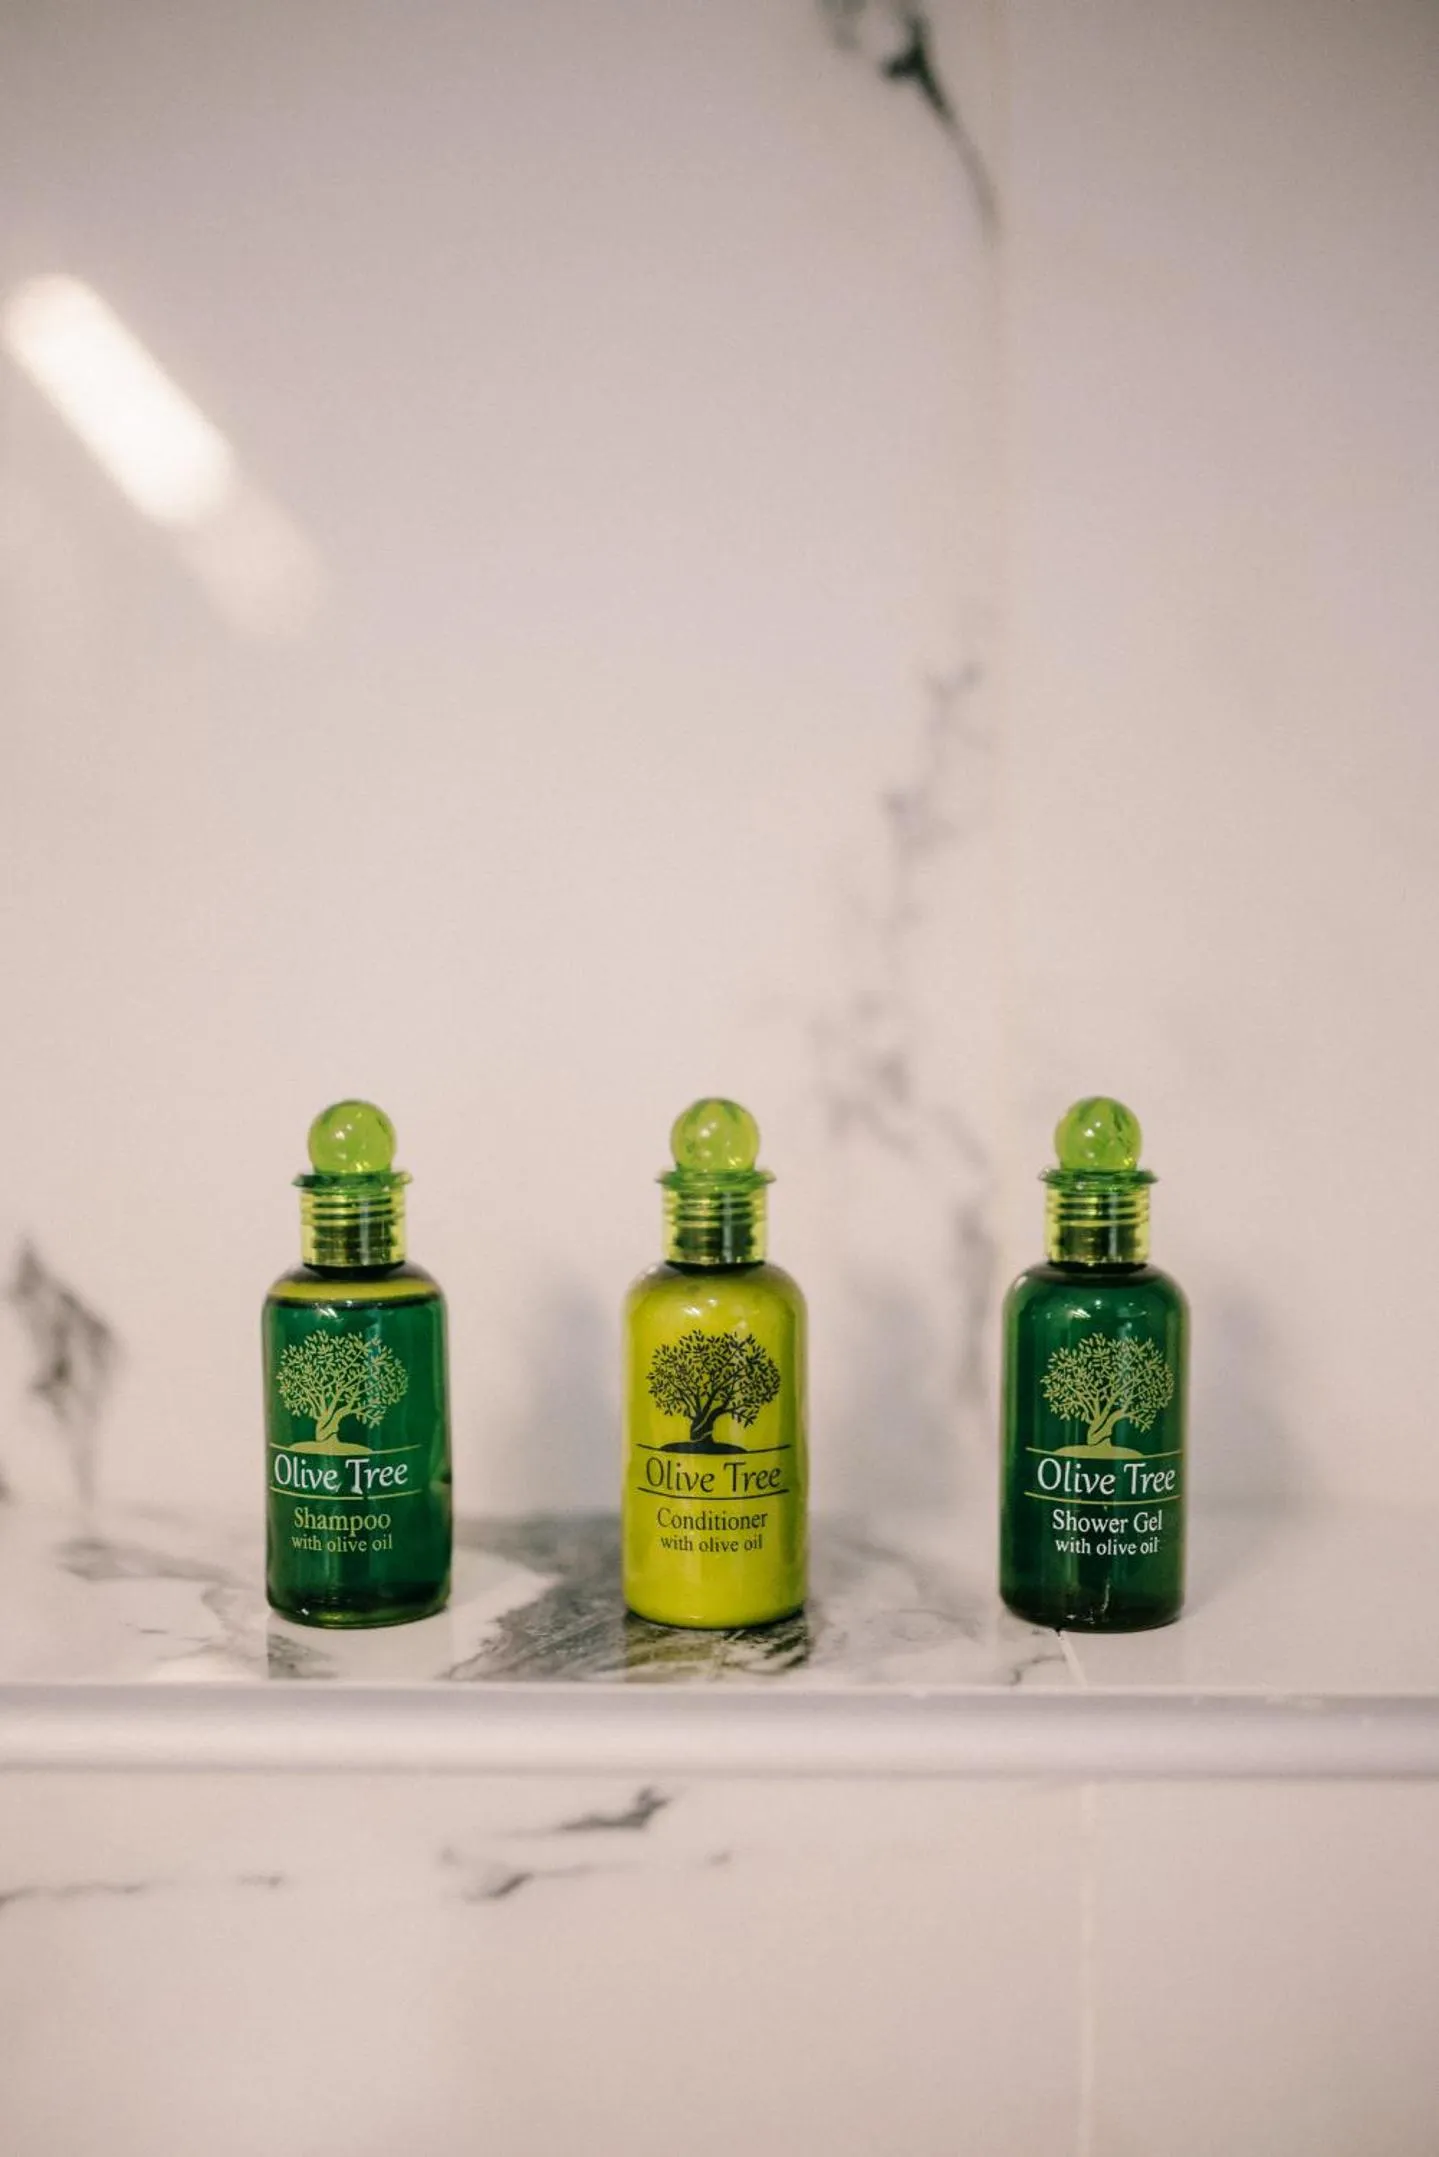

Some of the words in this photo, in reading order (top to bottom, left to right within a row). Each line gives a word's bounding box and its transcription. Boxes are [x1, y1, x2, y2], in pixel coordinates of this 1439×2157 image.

[274, 1453, 340, 1491] Olive
[345, 1458, 408, 1494] Tree
[646, 1457, 715, 1493] Olive
[723, 1461, 781, 1492] Tree
[1037, 1458, 1116, 1495] Olive
[1123, 1463, 1176, 1495] Tree
[294, 1506, 391, 1537] Shampoo
[657, 1507, 768, 1531] Conditioner
[1052, 1509, 1129, 1533] Shower
[1133, 1509, 1163, 1533] Gel
[291, 1534, 322, 1551] with
[326, 1536, 367, 1552] olive
[372, 1534, 393, 1550] oil
[660, 1535, 693, 1551] with
[698, 1536, 738, 1553] olive
[744, 1534, 763, 1551] oil
[1055, 1537, 1091, 1554] with
[1096, 1539, 1137, 1556] olive
[1140, 1537, 1159, 1553] oil
